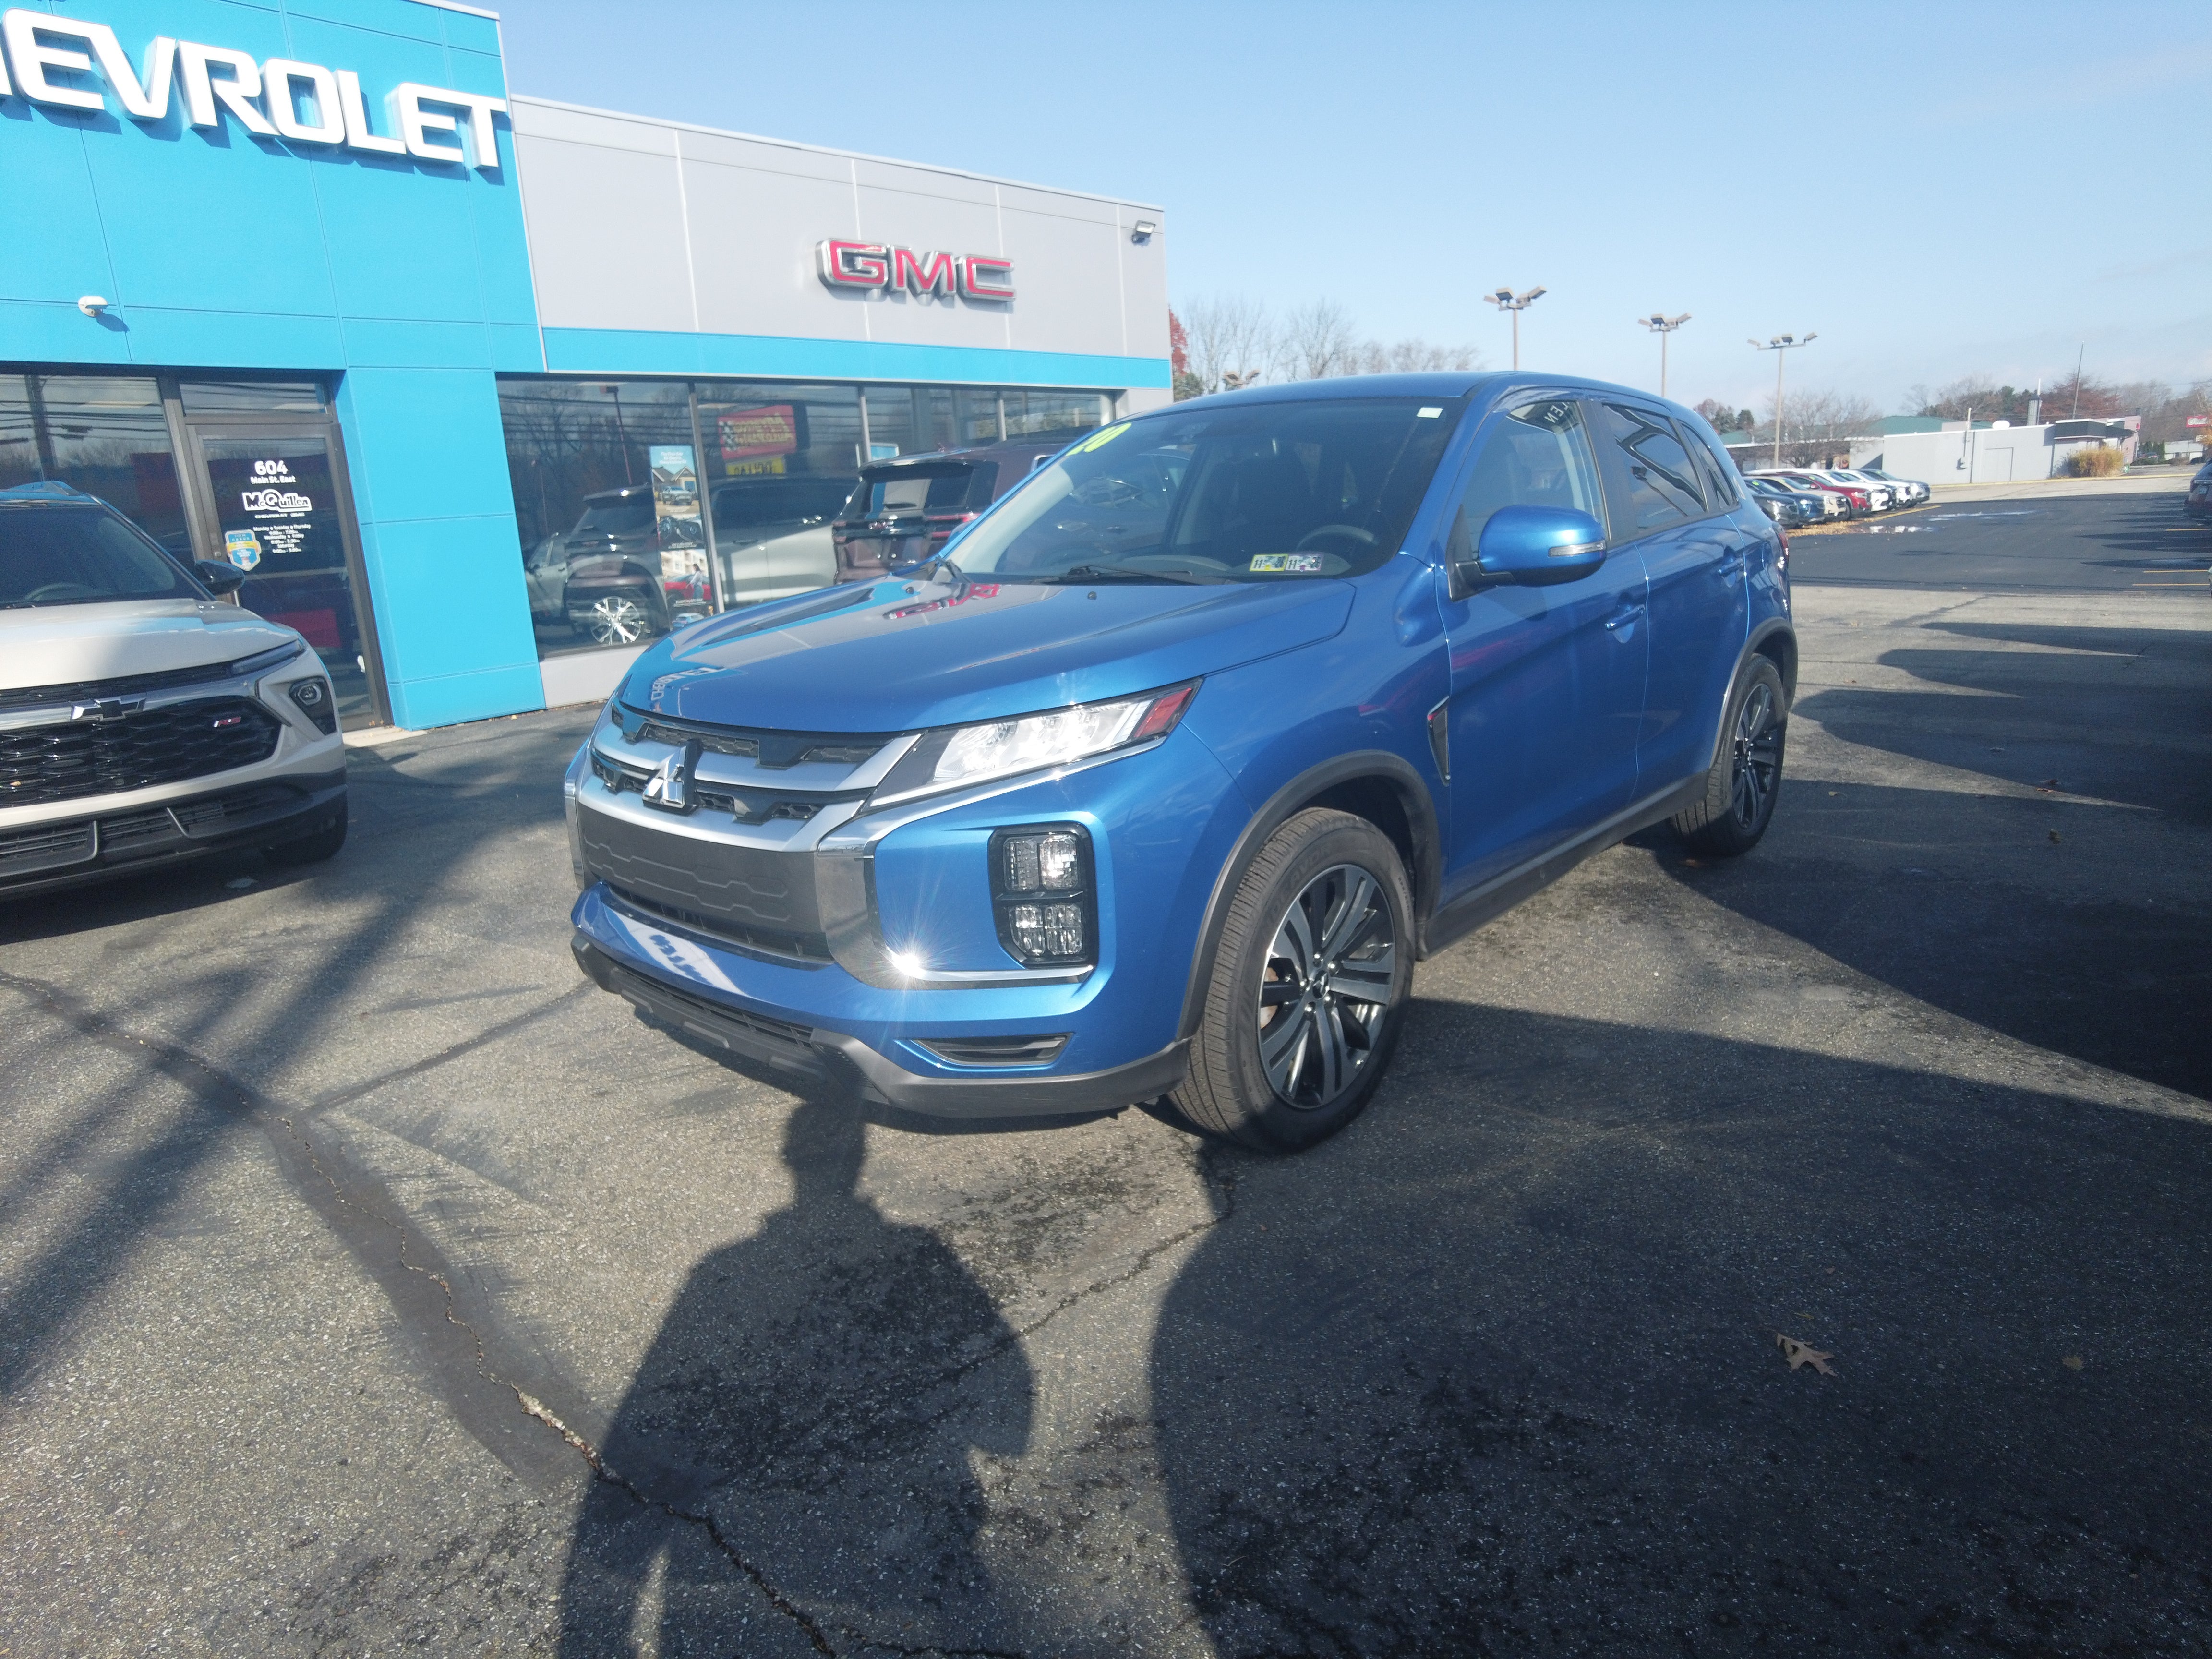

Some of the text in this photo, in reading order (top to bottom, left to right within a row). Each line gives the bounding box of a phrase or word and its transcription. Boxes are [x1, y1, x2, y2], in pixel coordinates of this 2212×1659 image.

[0, 7, 507, 168] EVROLET
[816, 238, 1016, 301] GMC
[255, 460, 288, 475] 604
[1254, 559, 1263, 568] 11
[1289, 559, 1298, 569] 11
